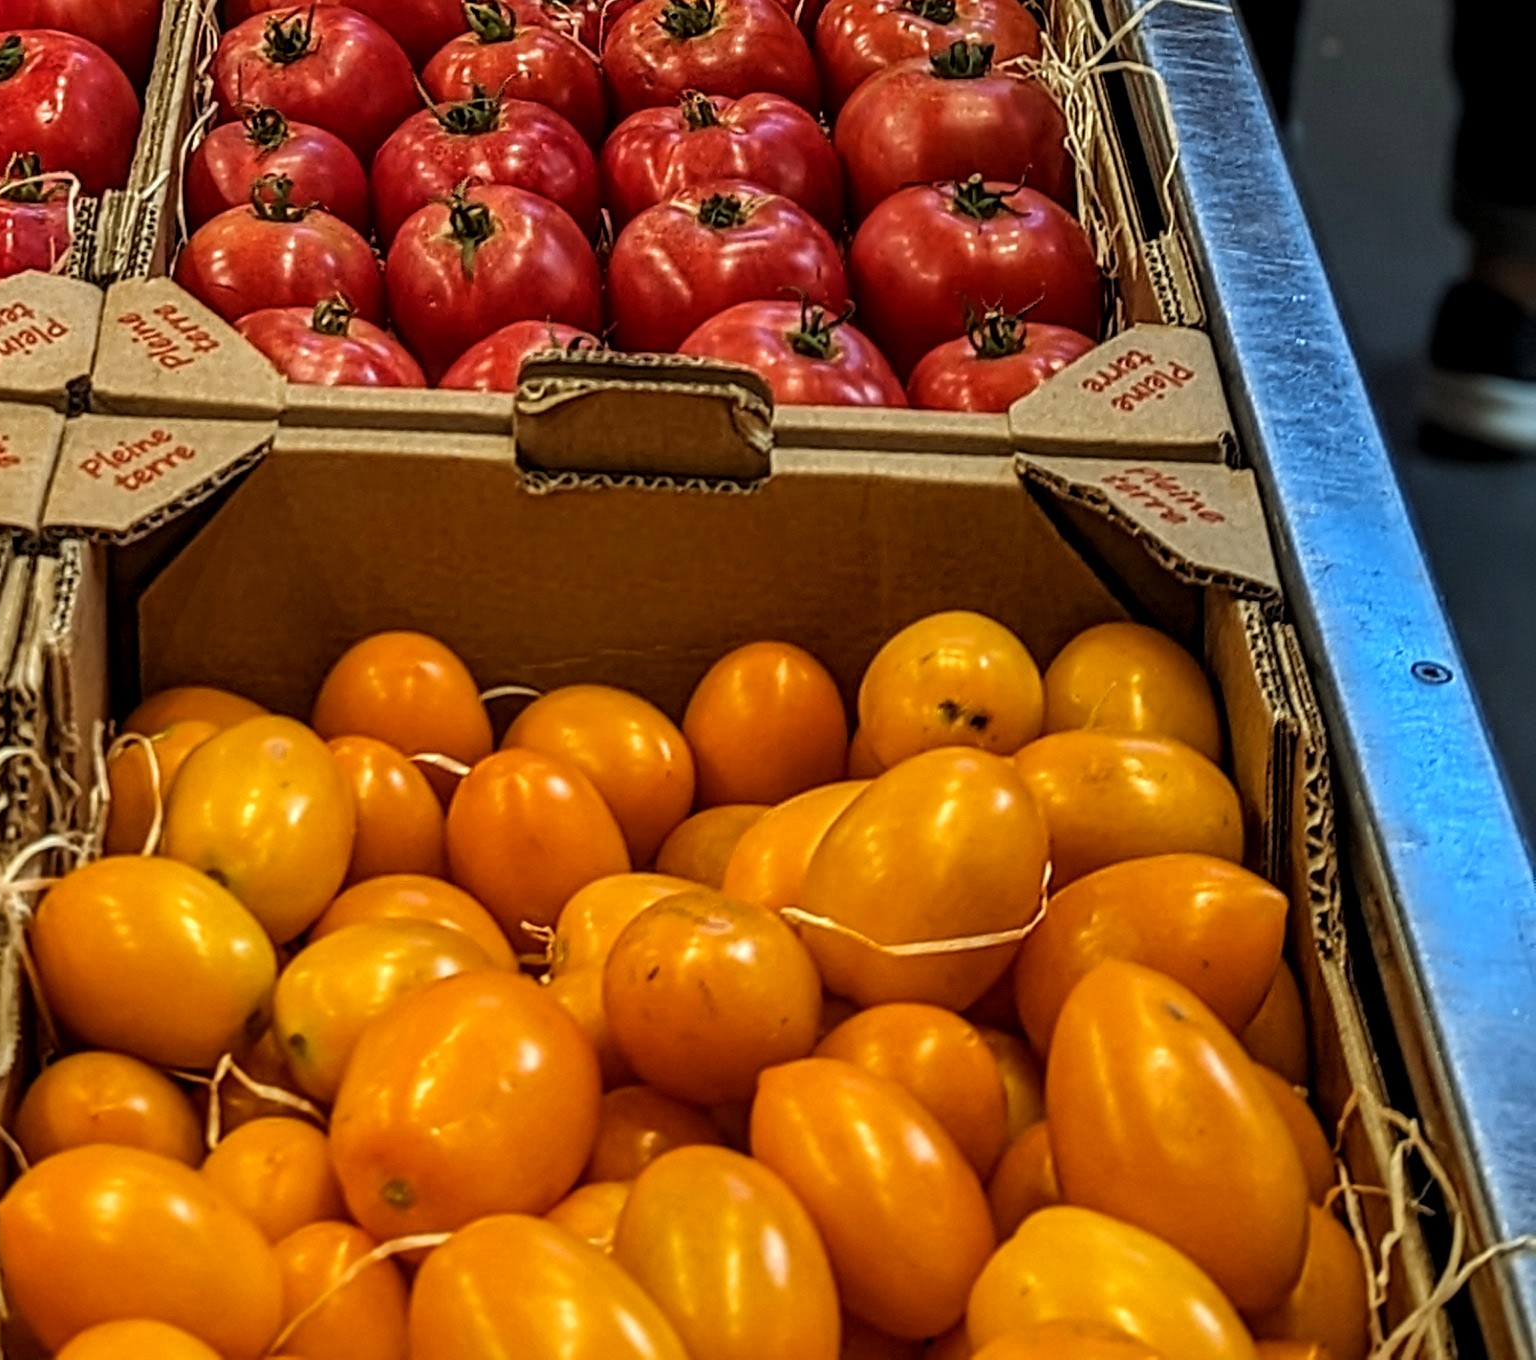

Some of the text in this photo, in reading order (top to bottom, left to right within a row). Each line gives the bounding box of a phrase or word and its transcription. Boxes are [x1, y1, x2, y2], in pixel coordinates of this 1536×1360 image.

[117, 312, 196, 372] Pleine
[153, 304, 221, 355] terre
[1082, 350, 1155, 393] terre
[1111, 361, 1196, 413] Pleine
[80, 429, 172, 479] Pleine
[114, 445, 195, 491] terre
